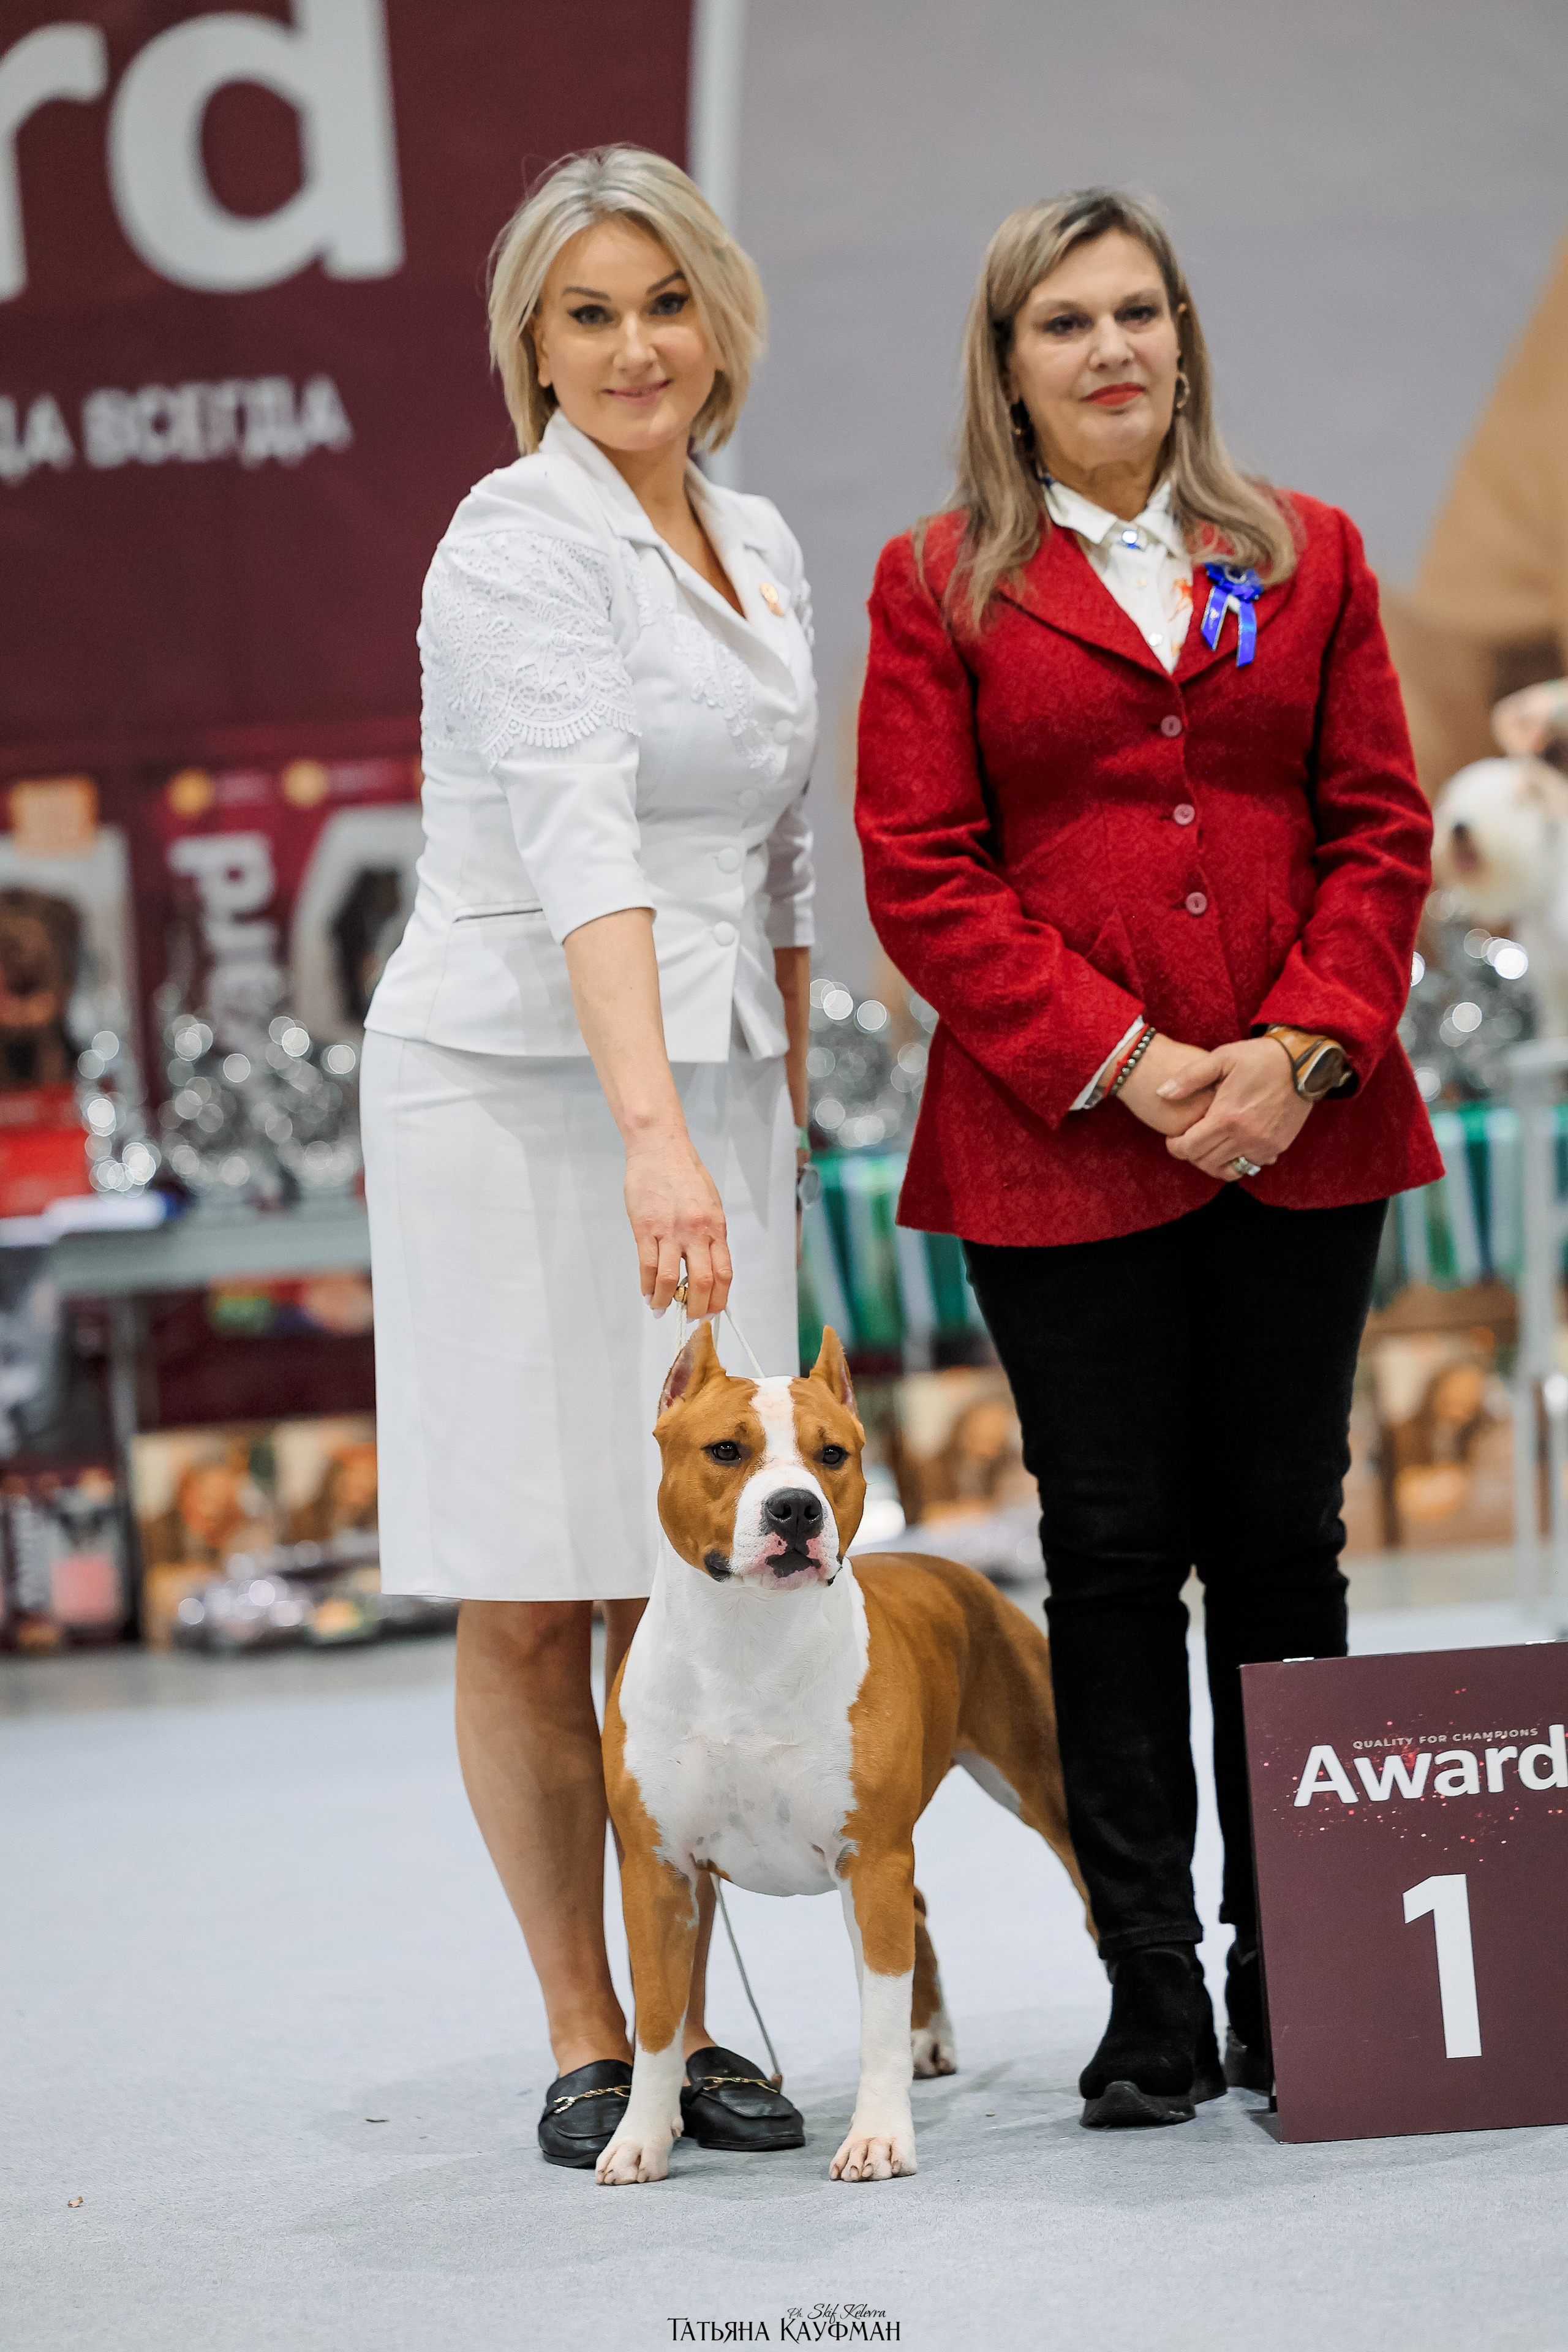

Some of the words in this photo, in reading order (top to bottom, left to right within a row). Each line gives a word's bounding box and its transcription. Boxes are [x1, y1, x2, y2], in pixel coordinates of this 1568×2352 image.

[1292, 1723, 1568, 1808] Award
[1352, 1737, 1414, 1750] QUALITY
[1419, 1734, 1447, 1744] FOR
[1452, 1727, 1539, 1742] CHAMPIONS
[1403, 1873, 1482, 2059] 1
